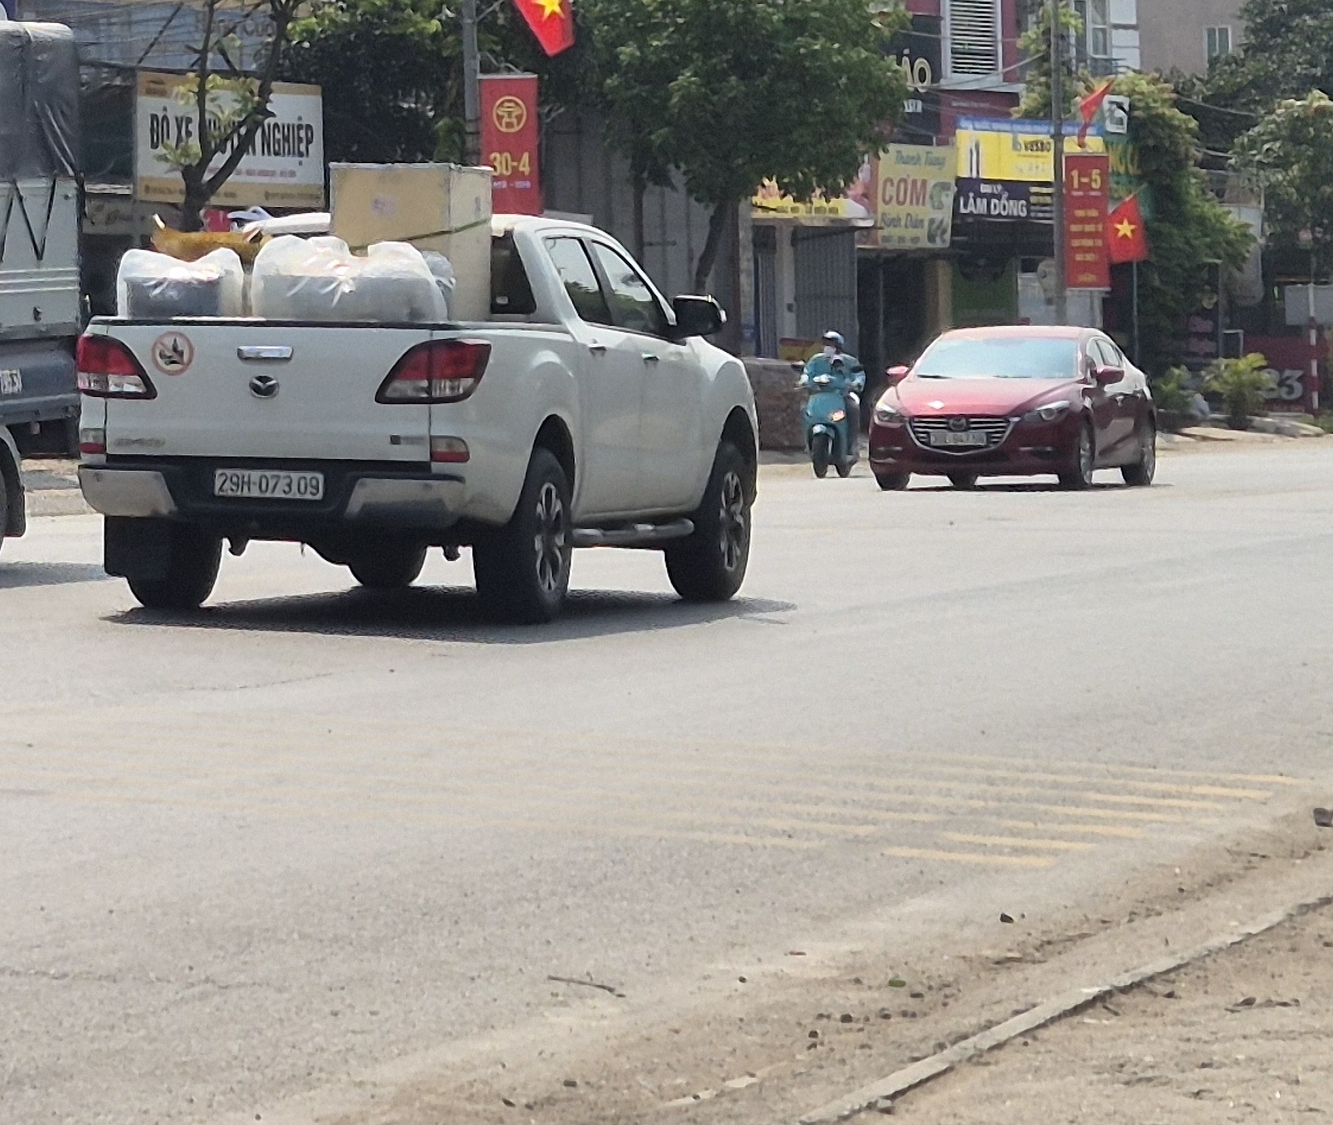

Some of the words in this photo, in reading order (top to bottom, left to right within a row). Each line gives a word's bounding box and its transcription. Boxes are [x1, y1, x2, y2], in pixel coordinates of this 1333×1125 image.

[261, 115, 314, 167] NGHIỆP
[490, 151, 530, 176] 30-4
[1071, 168, 1102, 189] 1-5
